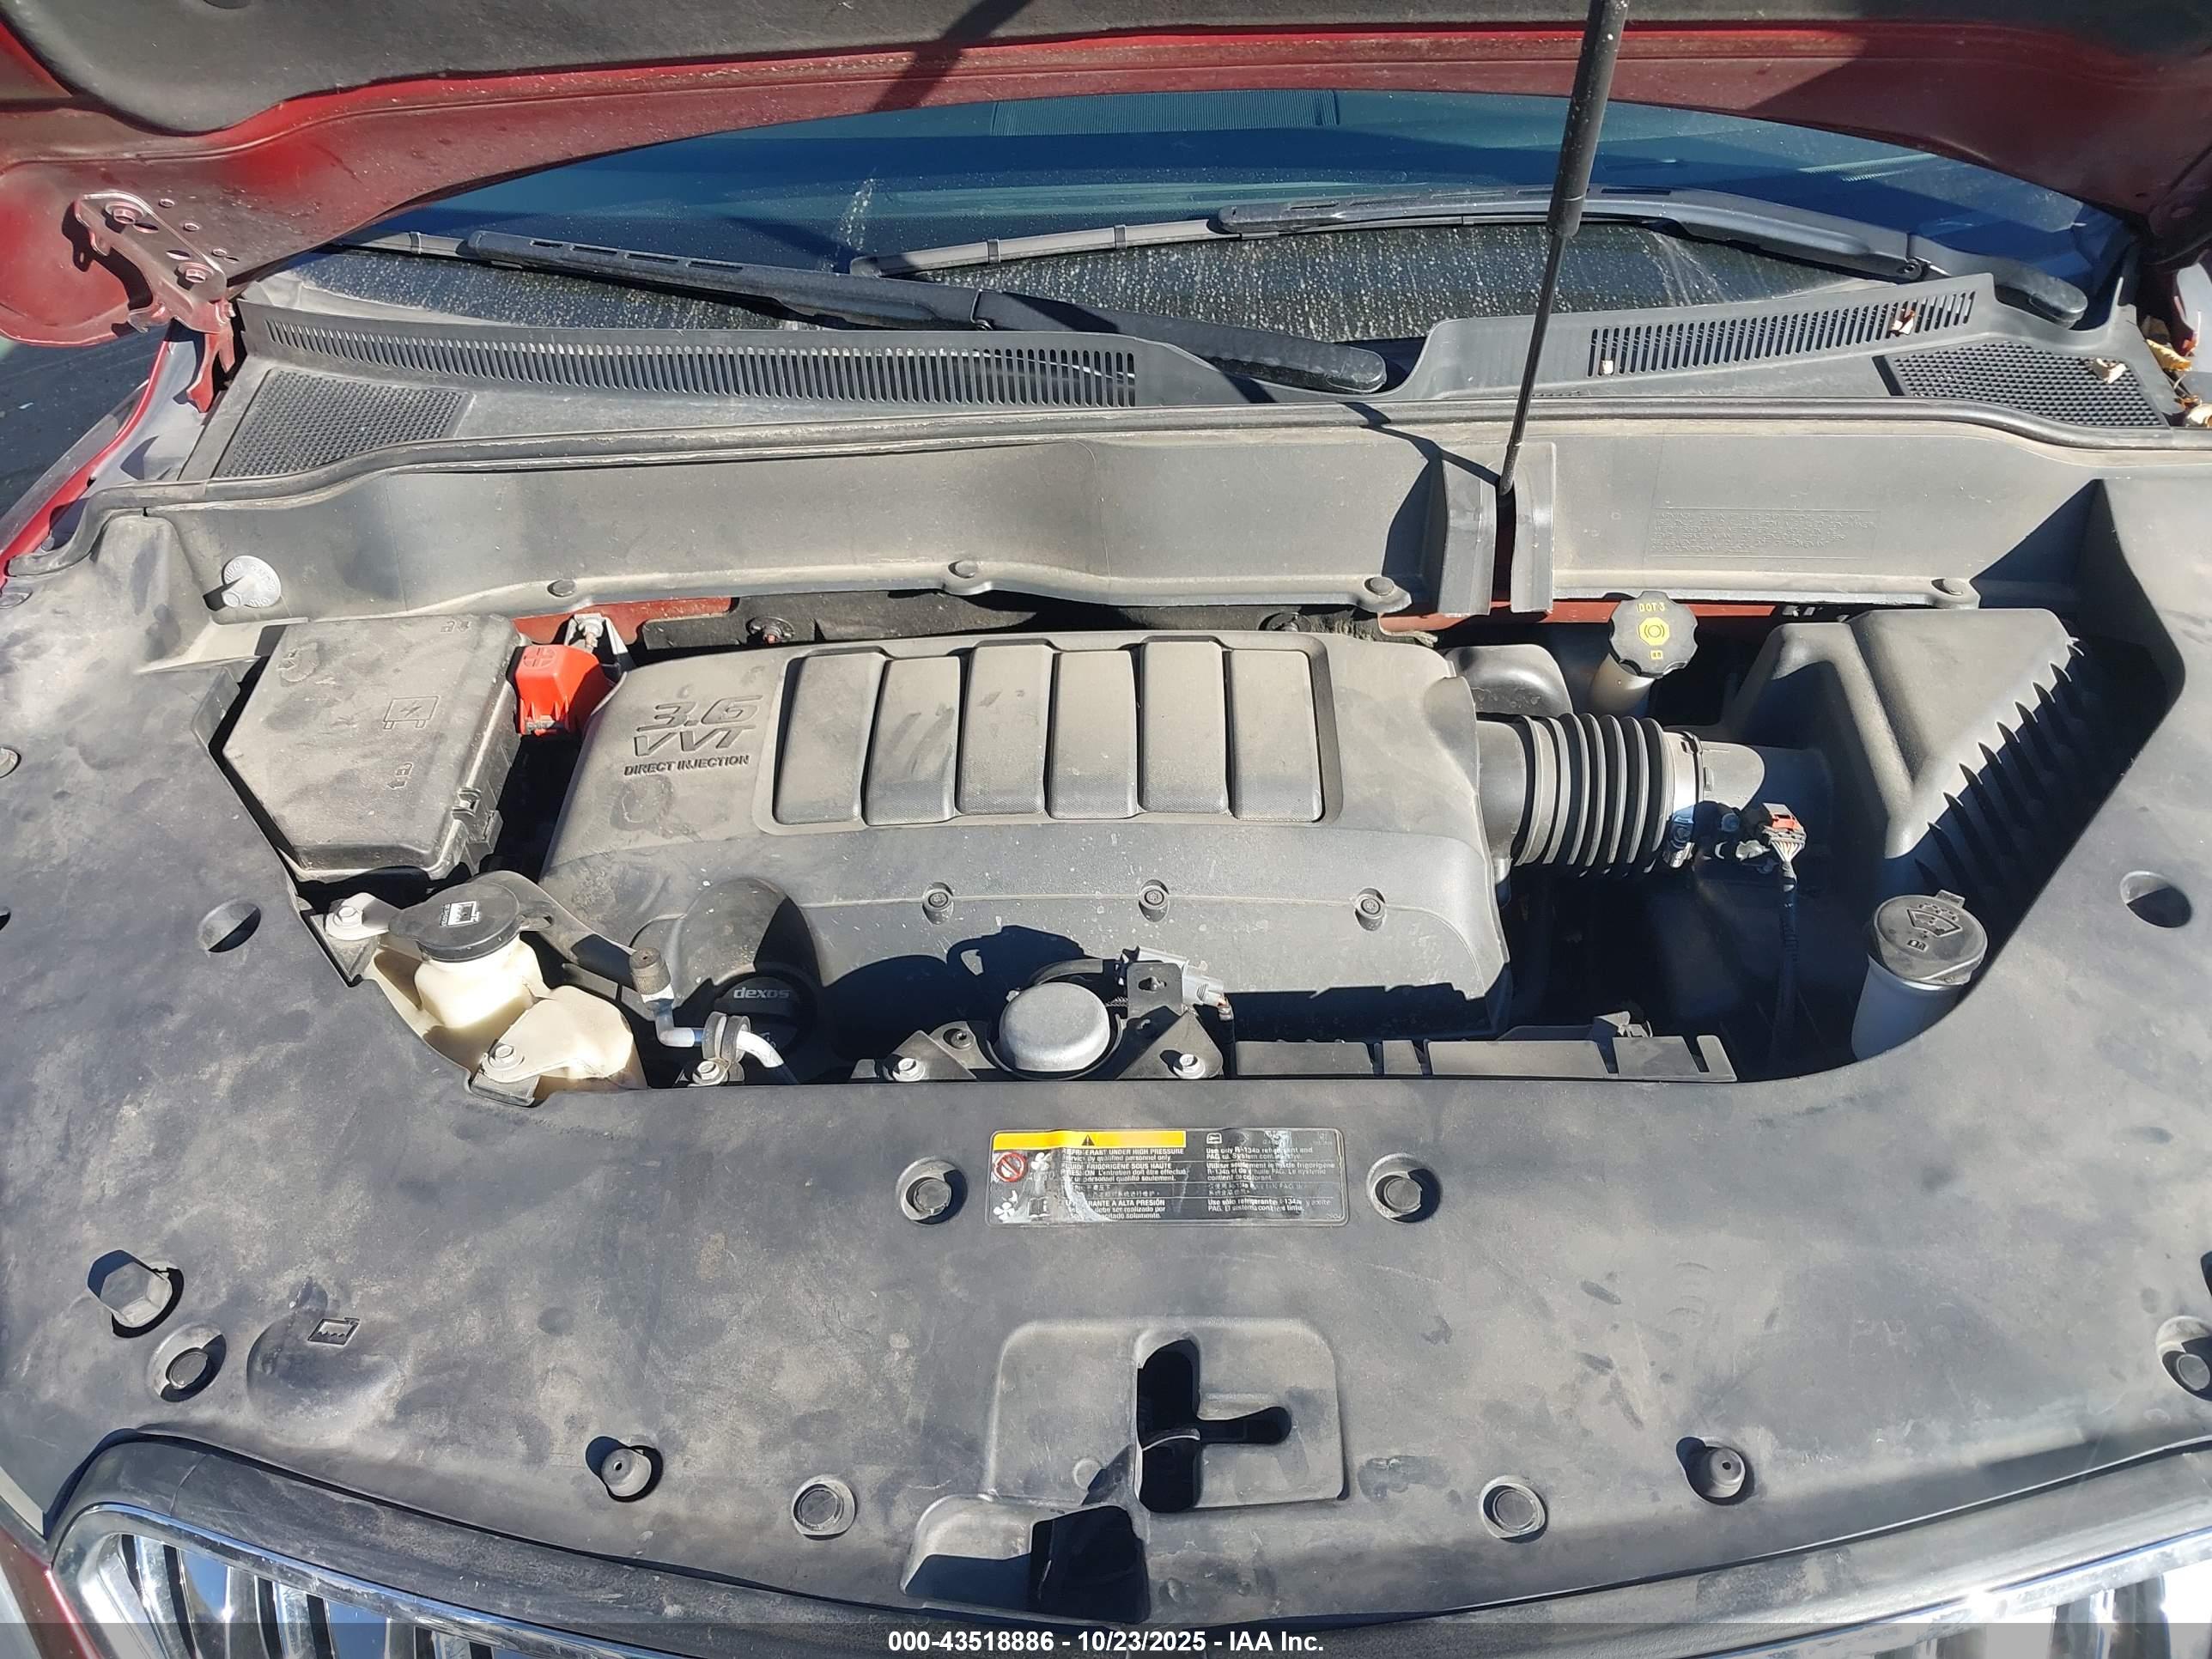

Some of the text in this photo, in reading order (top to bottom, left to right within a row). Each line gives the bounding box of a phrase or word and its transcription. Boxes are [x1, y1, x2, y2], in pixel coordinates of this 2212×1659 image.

[1638, 603, 1657, 612] DOT
[637, 695, 763, 732] 3.6
[634, 726, 757, 757] VVT
[623, 755, 750, 775] DIRECT INJECTION
[733, 987, 790, 999] dexos
